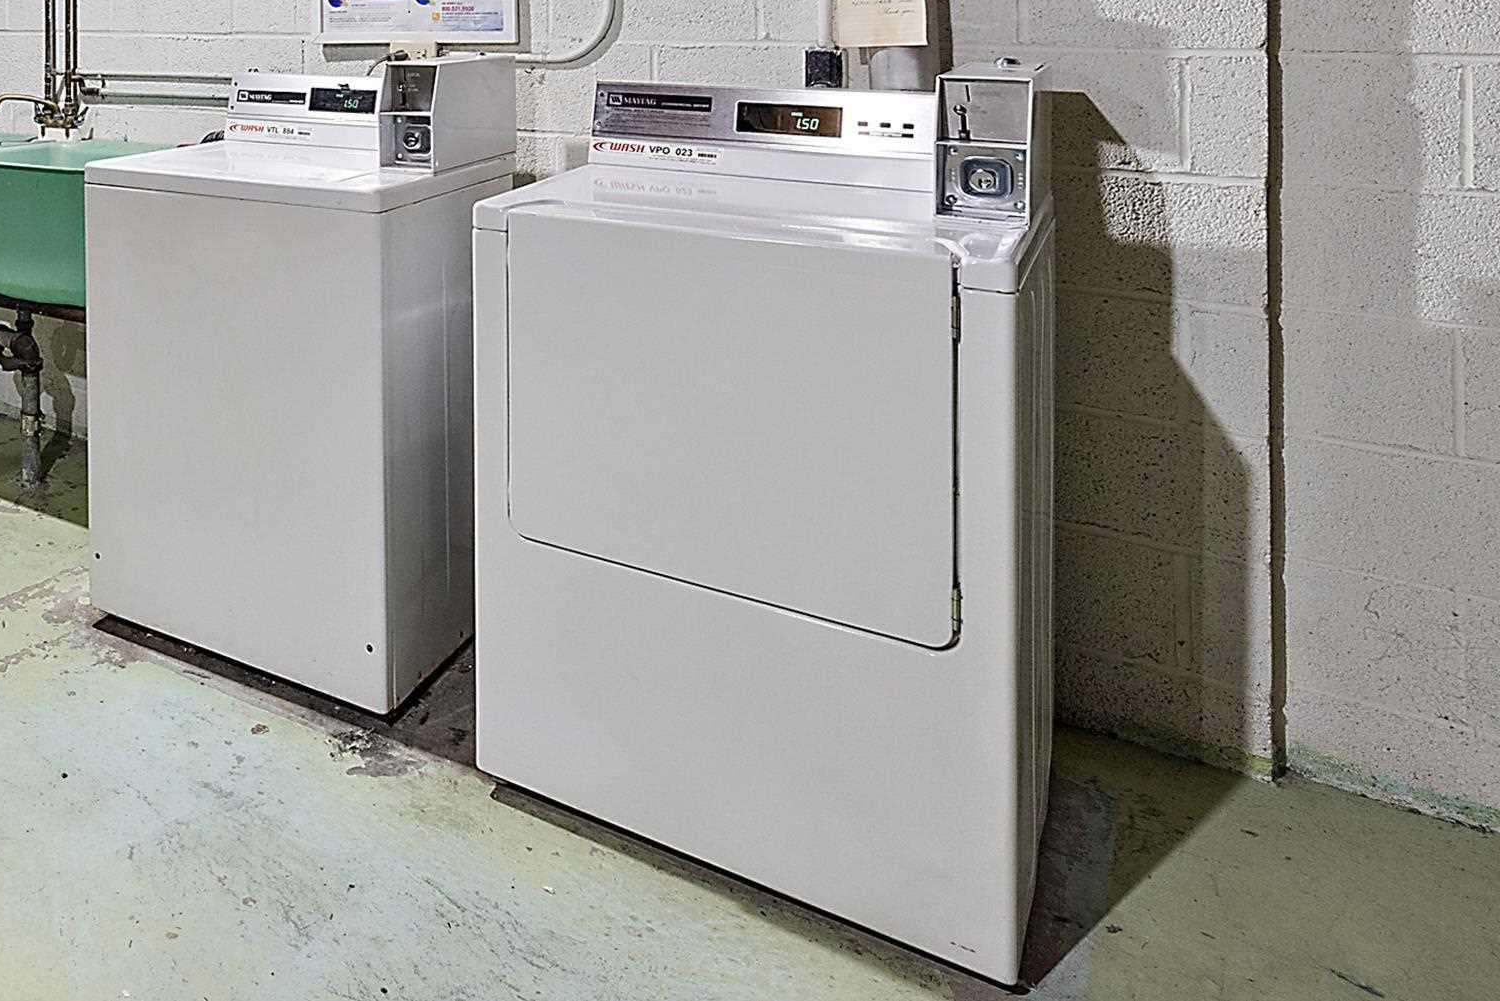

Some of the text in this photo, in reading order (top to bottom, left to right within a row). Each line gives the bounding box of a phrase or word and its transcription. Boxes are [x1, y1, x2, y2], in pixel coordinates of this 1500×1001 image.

[624, 96, 657, 105] MAYTAG
[240, 123, 265, 133] WASH
[267, 125, 278, 134] VTL
[609, 142, 645, 153] WASH
[649, 145, 670, 155] VPO
[675, 149, 693, 157] 023
